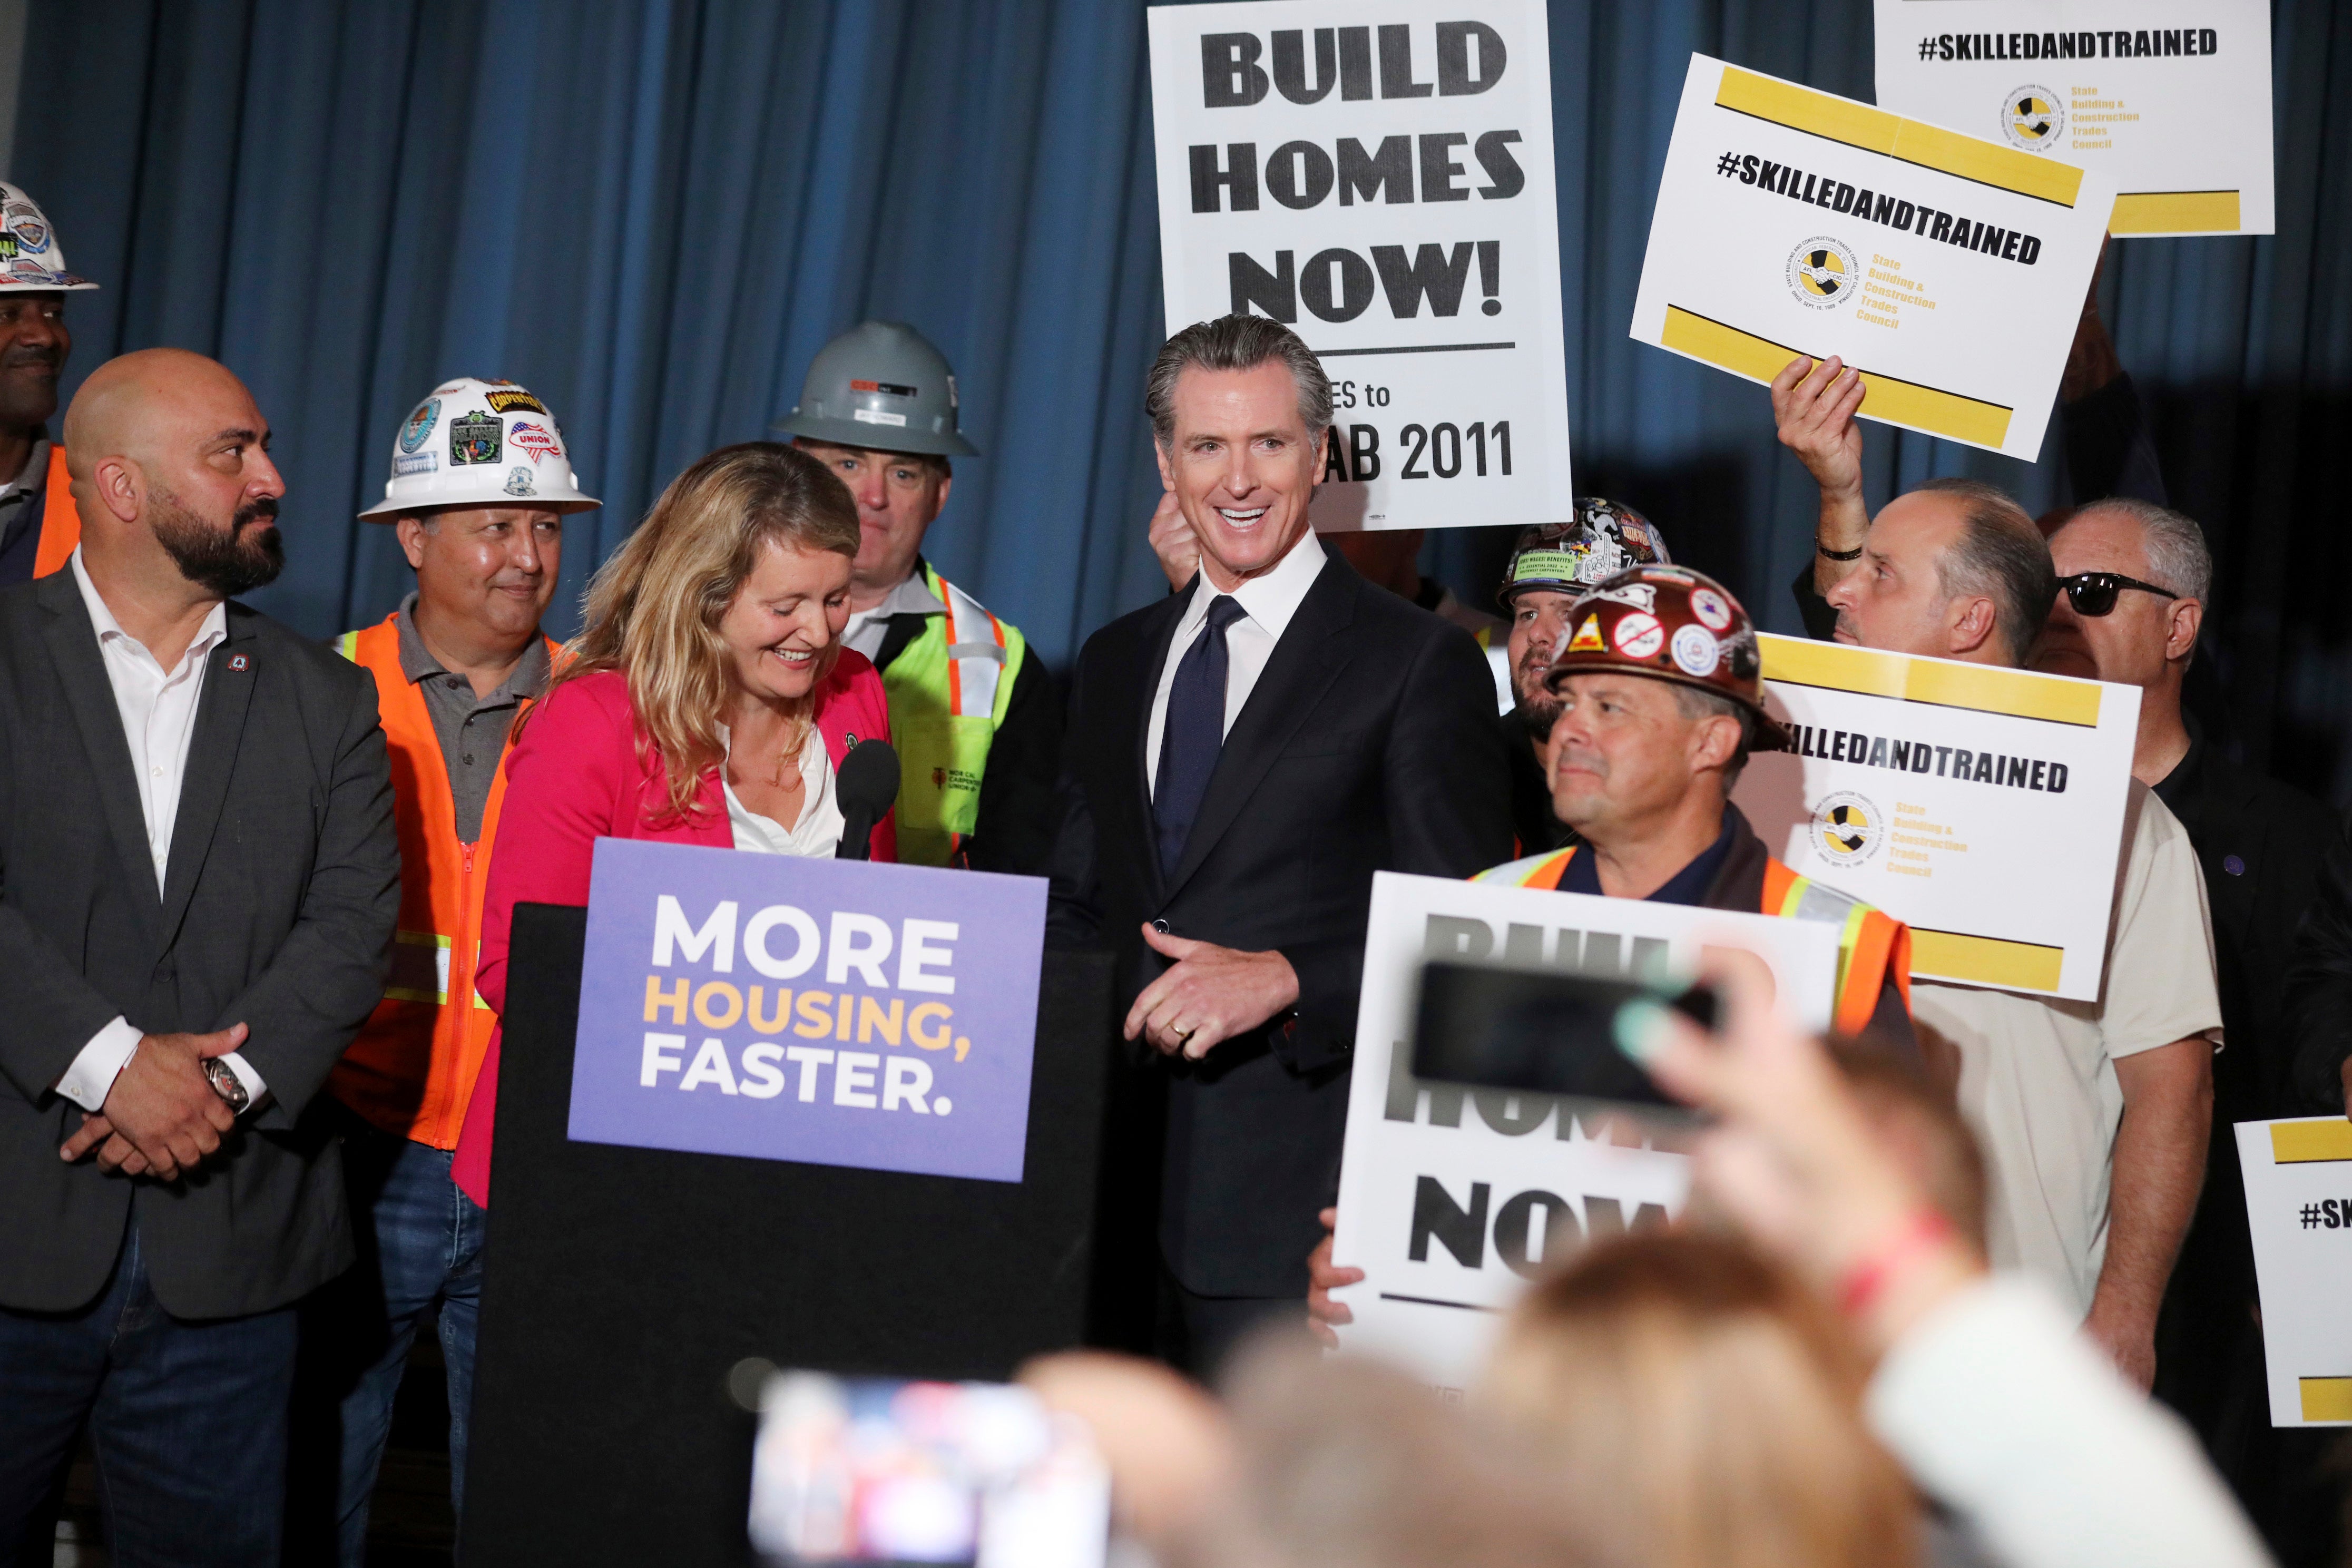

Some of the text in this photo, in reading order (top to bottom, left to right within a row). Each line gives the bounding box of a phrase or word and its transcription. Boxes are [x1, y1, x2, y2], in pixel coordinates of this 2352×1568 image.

[1918, 29, 2217, 61] #SKILLEDANDTRAINED
[1200, 20, 1507, 109] BUILD
[2071, 87, 2098, 95] State
[2072, 100, 2115, 110] Building
[2072, 113, 2139, 122] Construction
[2072, 127, 2107, 135] Trades
[2072, 140, 2112, 149] Council
[1188, 130, 1525, 213] HOMES
[1717, 151, 2042, 266] #SKILLEDANDTRAINED
[1793, 243, 1802, 252] AND
[1801, 236, 1836, 246] CONSTRUCTION
[1836, 239, 1850, 252] TRADES
[1786, 251, 1796, 272] BUILDING
[1849, 253, 1859, 272] COUNCIL
[1872, 253, 1901, 270] State
[1228, 241, 1502, 324] NOW!
[1868, 267, 1924, 292] Building &
[1838, 281, 1858, 305] CALIFORNIA
[1864, 281, 1936, 310] Construction
[1861, 295, 1898, 314] Trades
[1856, 309, 1899, 329] Council
[486, 392, 547, 415] CARPENTERS
[1365, 384, 1390, 407] to
[520, 436, 550, 444] UNION
[1321, 421, 1512, 483] AB 2011
[1896, 802, 1925, 816] State
[1894, 817, 1942, 834] Building
[1891, 832, 1968, 852] Construction
[1889, 847, 1929, 861] Trades
[1887, 861, 1932, 877] Council
[652, 894, 959, 995] MORE
[643, 975, 971, 1063] HOUSING,
[640, 1032, 953, 1116] FASTER.
